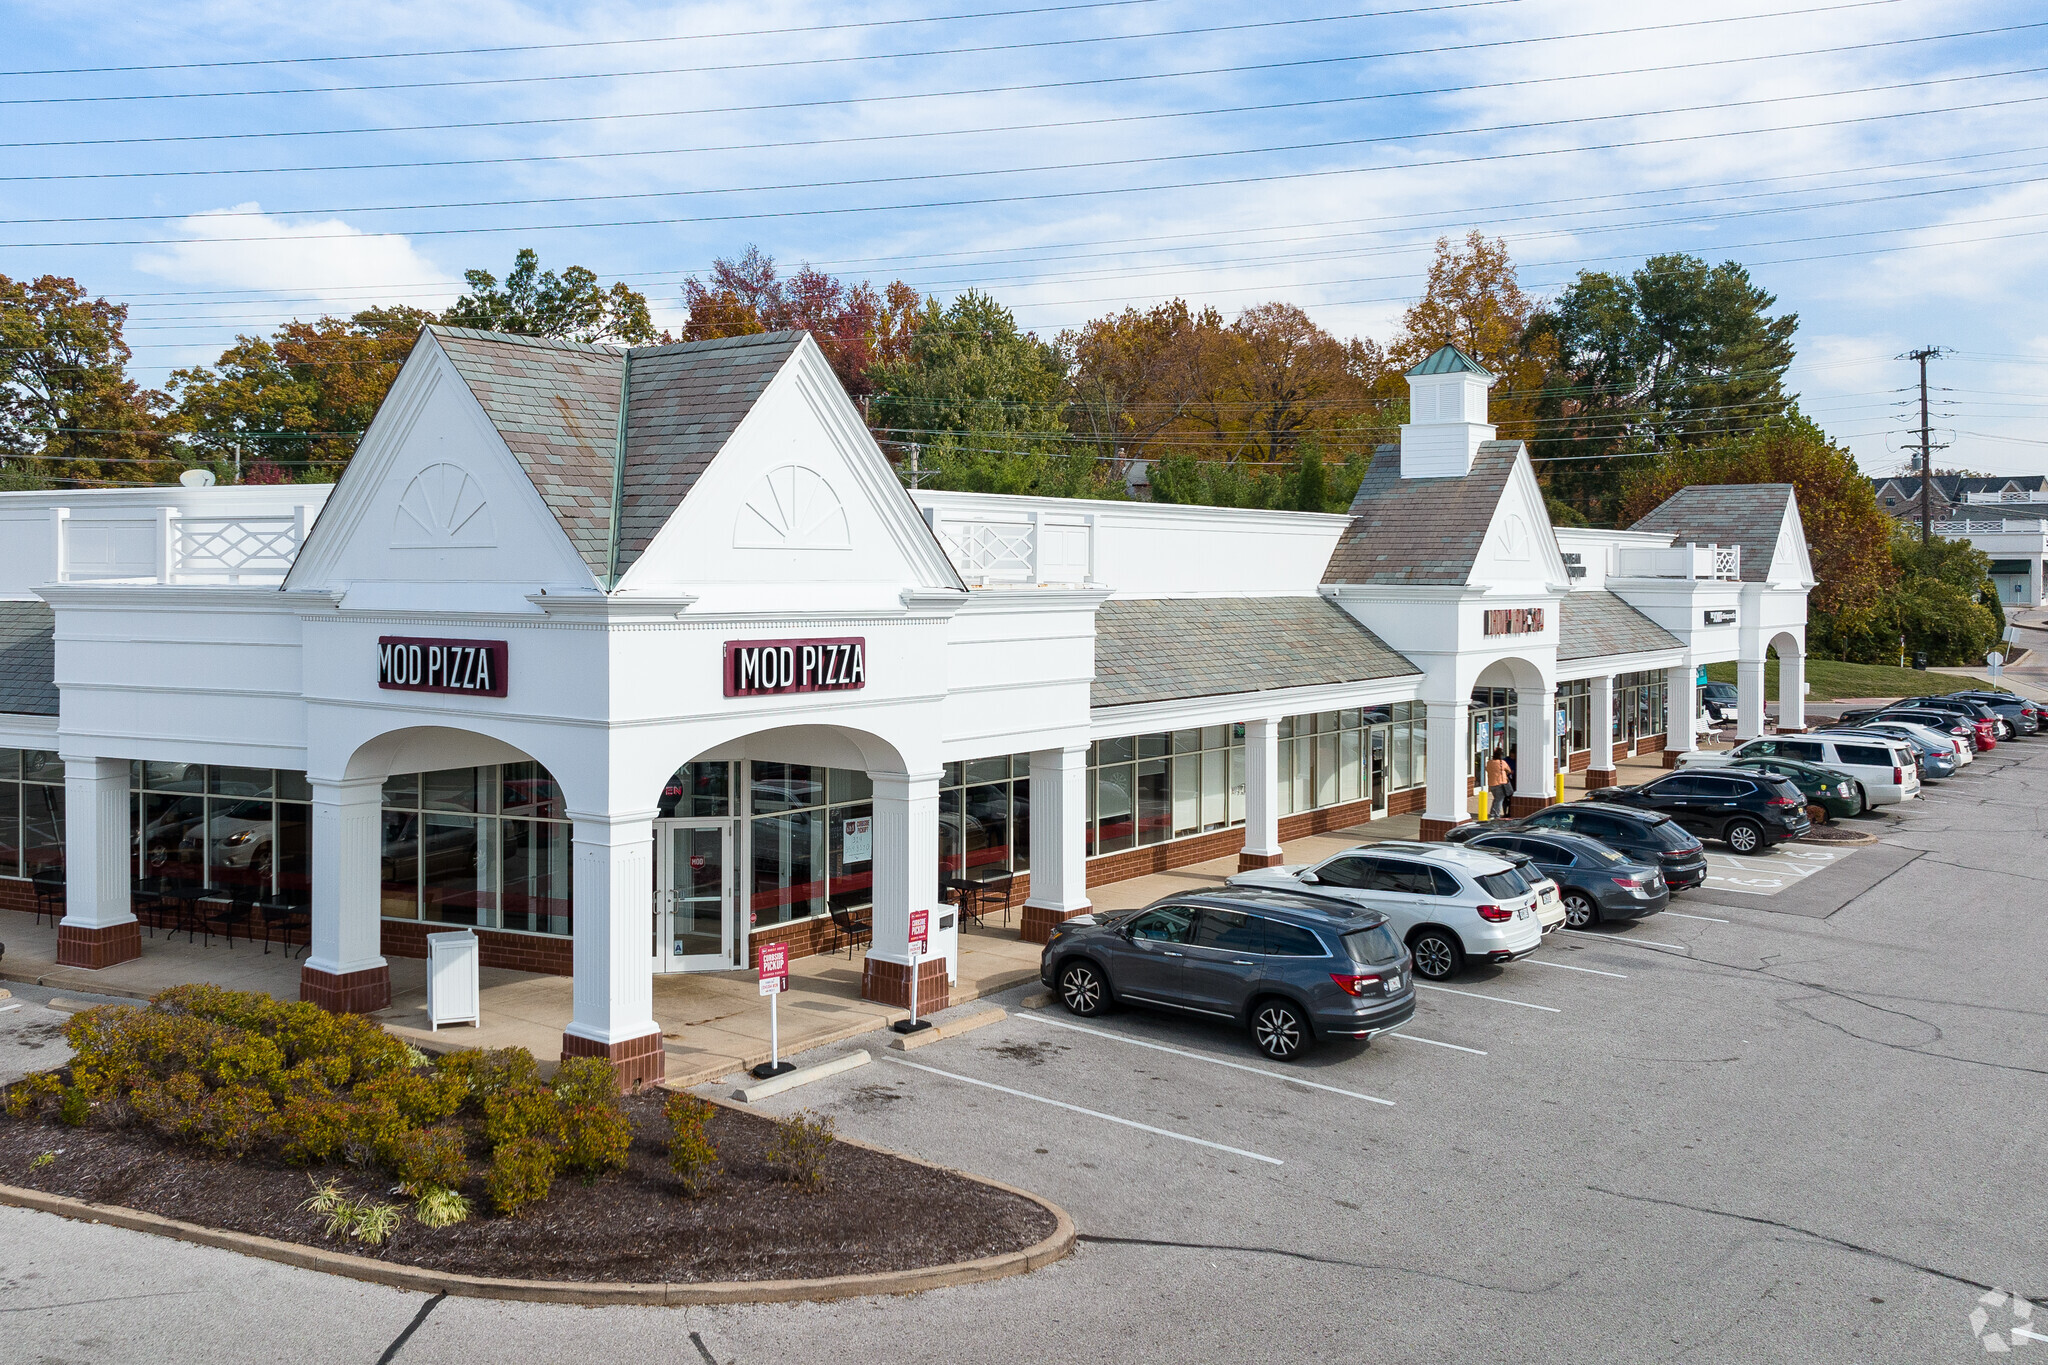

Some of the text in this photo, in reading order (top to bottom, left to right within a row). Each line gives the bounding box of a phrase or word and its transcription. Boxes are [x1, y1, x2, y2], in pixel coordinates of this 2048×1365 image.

[377, 643, 490, 691] MOD PIZZA
[741, 644, 865, 690] MOD PIZZA
[691, 858, 704, 866] MOD
[763, 952, 784, 963] CURBSIDE
[763, 960, 785, 972] PICKUP
